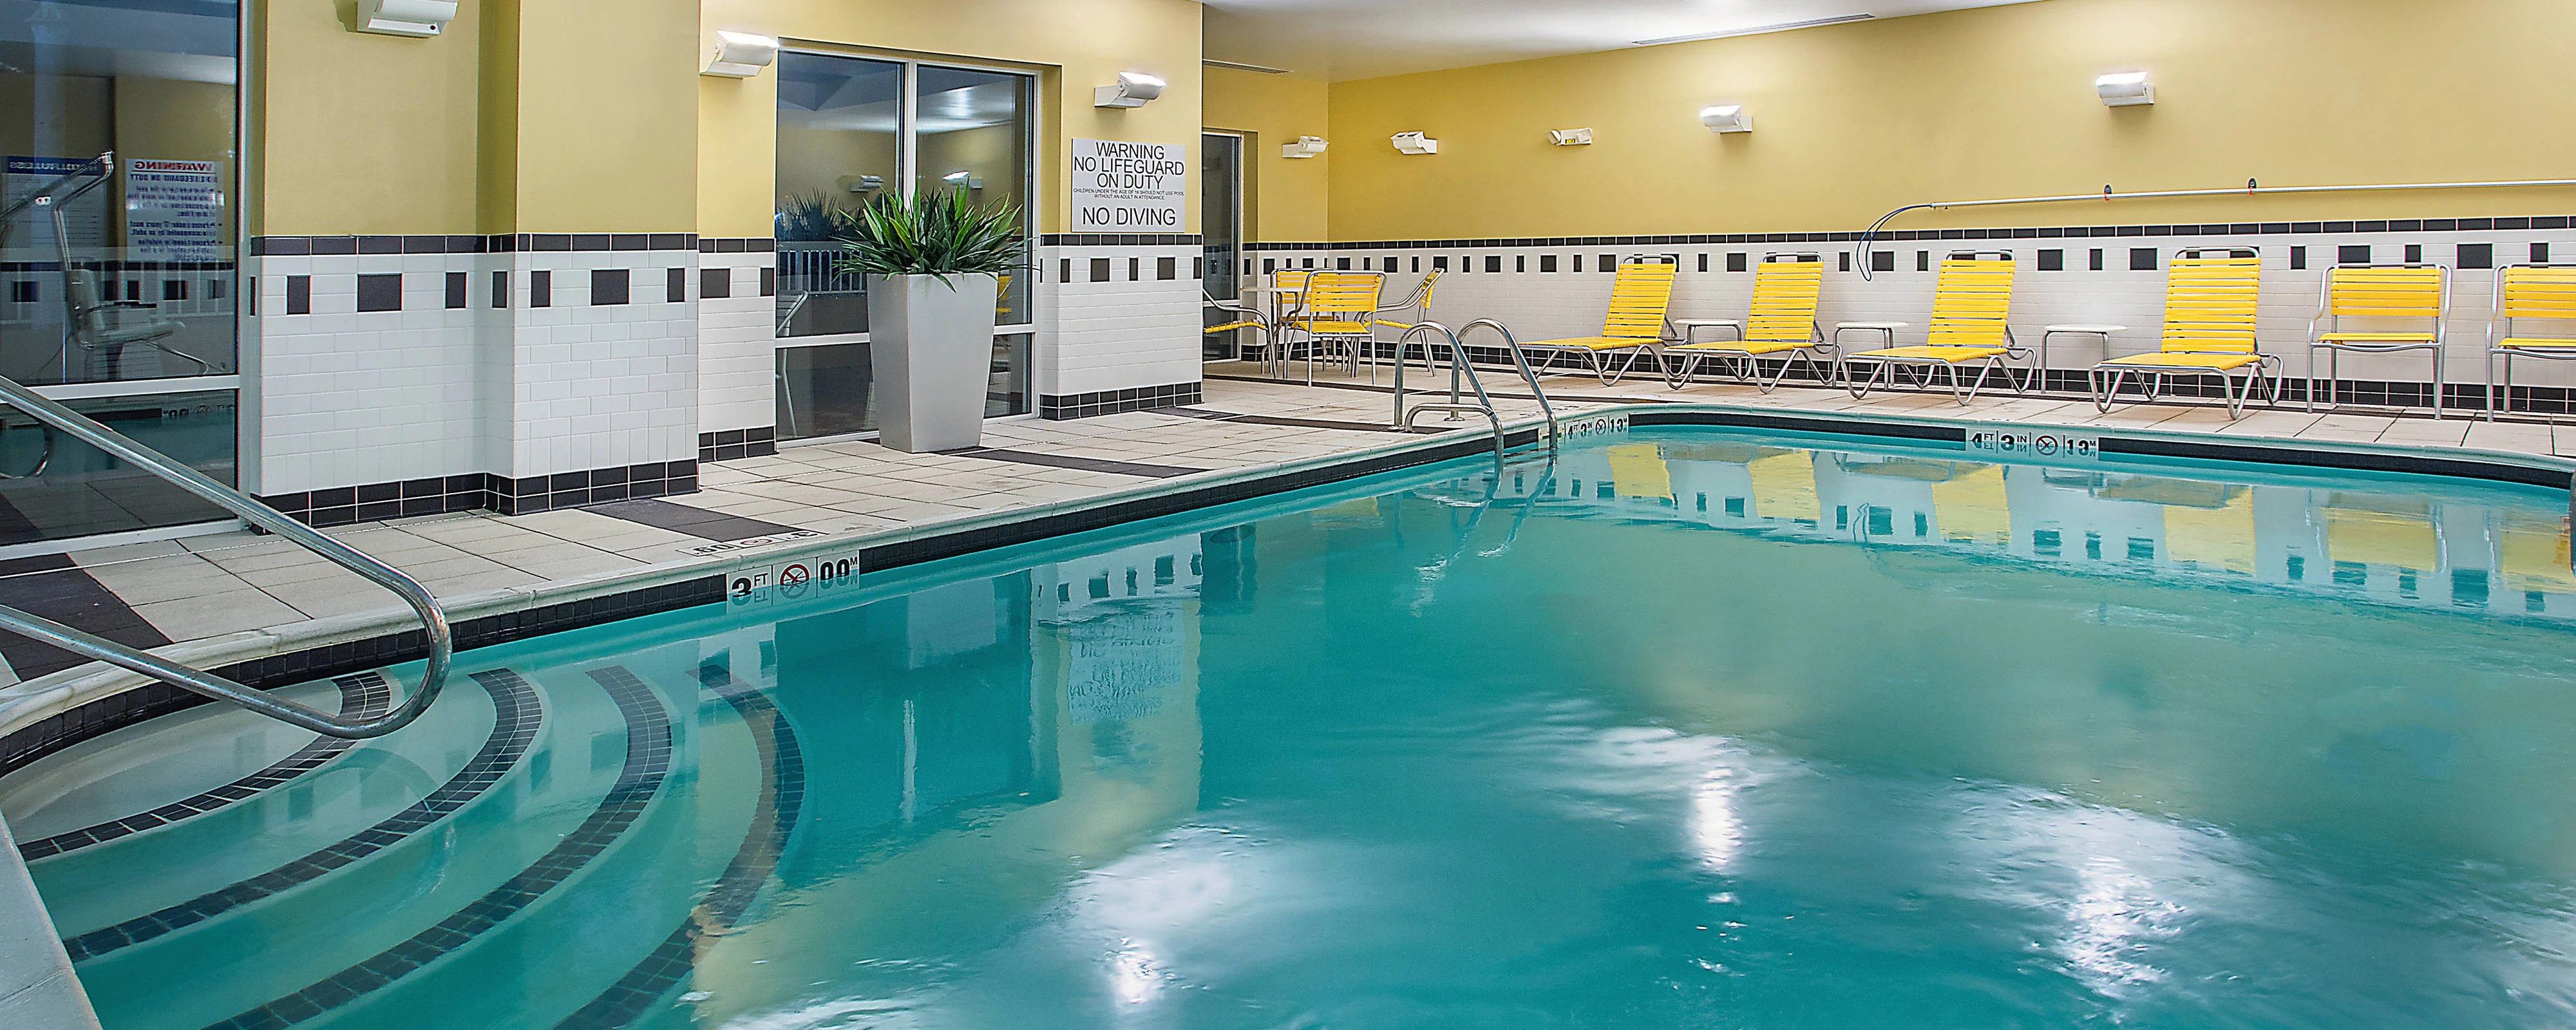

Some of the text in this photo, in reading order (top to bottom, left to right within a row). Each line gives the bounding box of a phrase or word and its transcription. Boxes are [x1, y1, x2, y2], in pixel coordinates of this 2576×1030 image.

[1095, 142, 1164, 160] WARNING
[1074, 156, 1184, 176] NO LIFEGUARD
[1097, 173, 1164, 189] ON DUTY
[1083, 207, 1176, 226] NO DIVING
[1984, 433, 1994, 442] FT
[753, 572, 768, 586] FT
[850, 556, 858, 566] M
